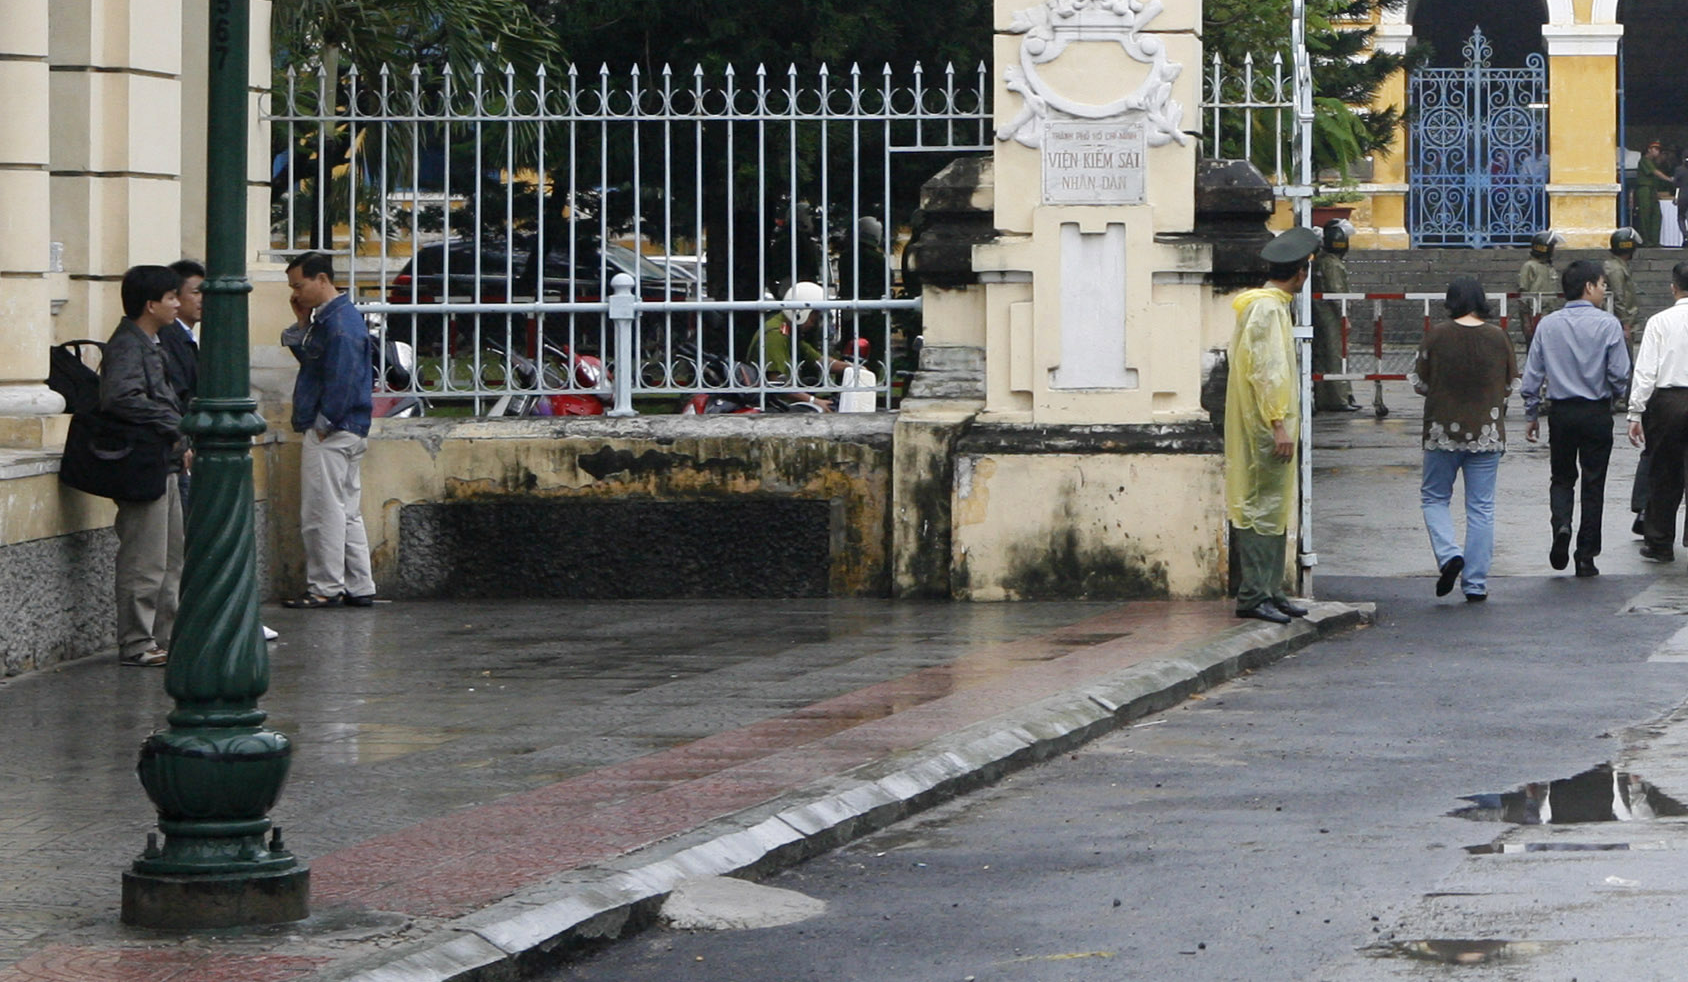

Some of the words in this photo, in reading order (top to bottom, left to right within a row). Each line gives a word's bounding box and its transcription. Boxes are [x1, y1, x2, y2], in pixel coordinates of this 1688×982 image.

[1048, 150, 1078, 170] VIỆN
[1118, 149, 1140, 169] SÁT
[1062, 175, 1096, 190] NHÂN
